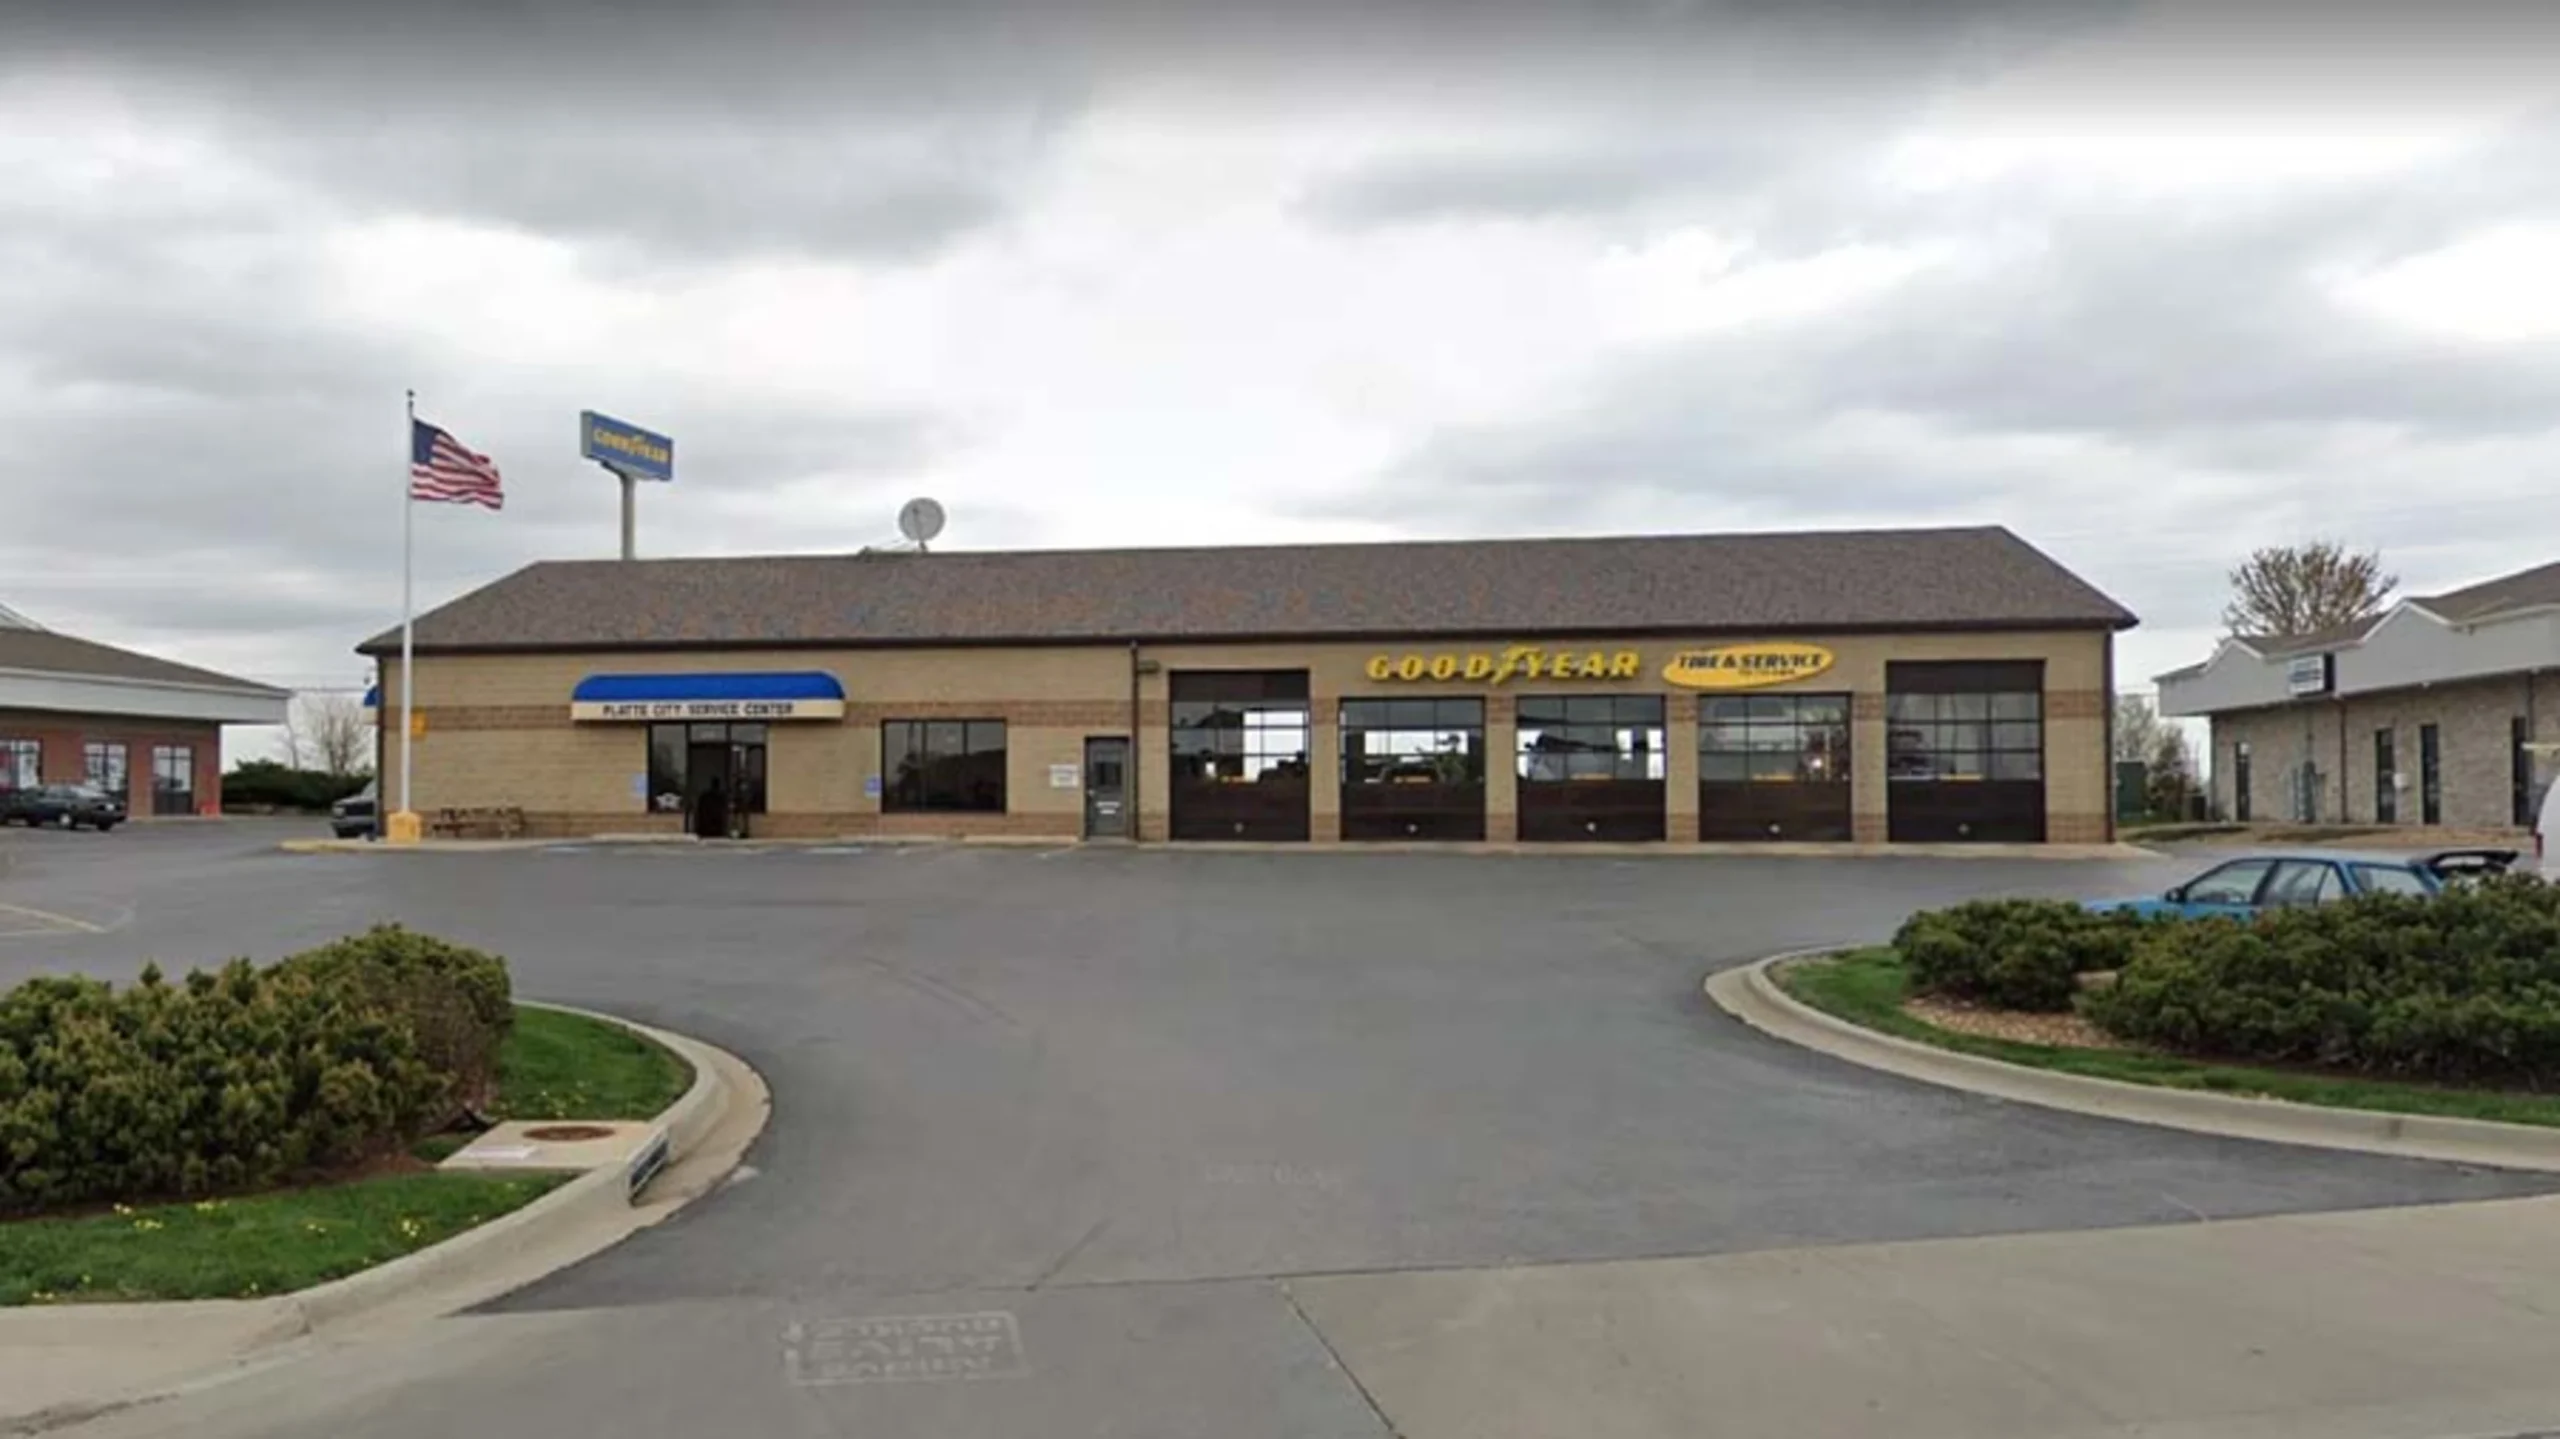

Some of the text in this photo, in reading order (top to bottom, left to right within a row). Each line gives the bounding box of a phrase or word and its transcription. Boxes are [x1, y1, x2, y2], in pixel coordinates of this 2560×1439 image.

[1366, 645, 1639, 685] GOODYEAR
[1679, 653, 1717, 668] TIRE
[1740, 652, 1820, 668] SERVICE
[653, 704, 682, 717] CITY
[687, 703, 738, 715] SERVICE
[744, 702, 793, 715] CENTER
